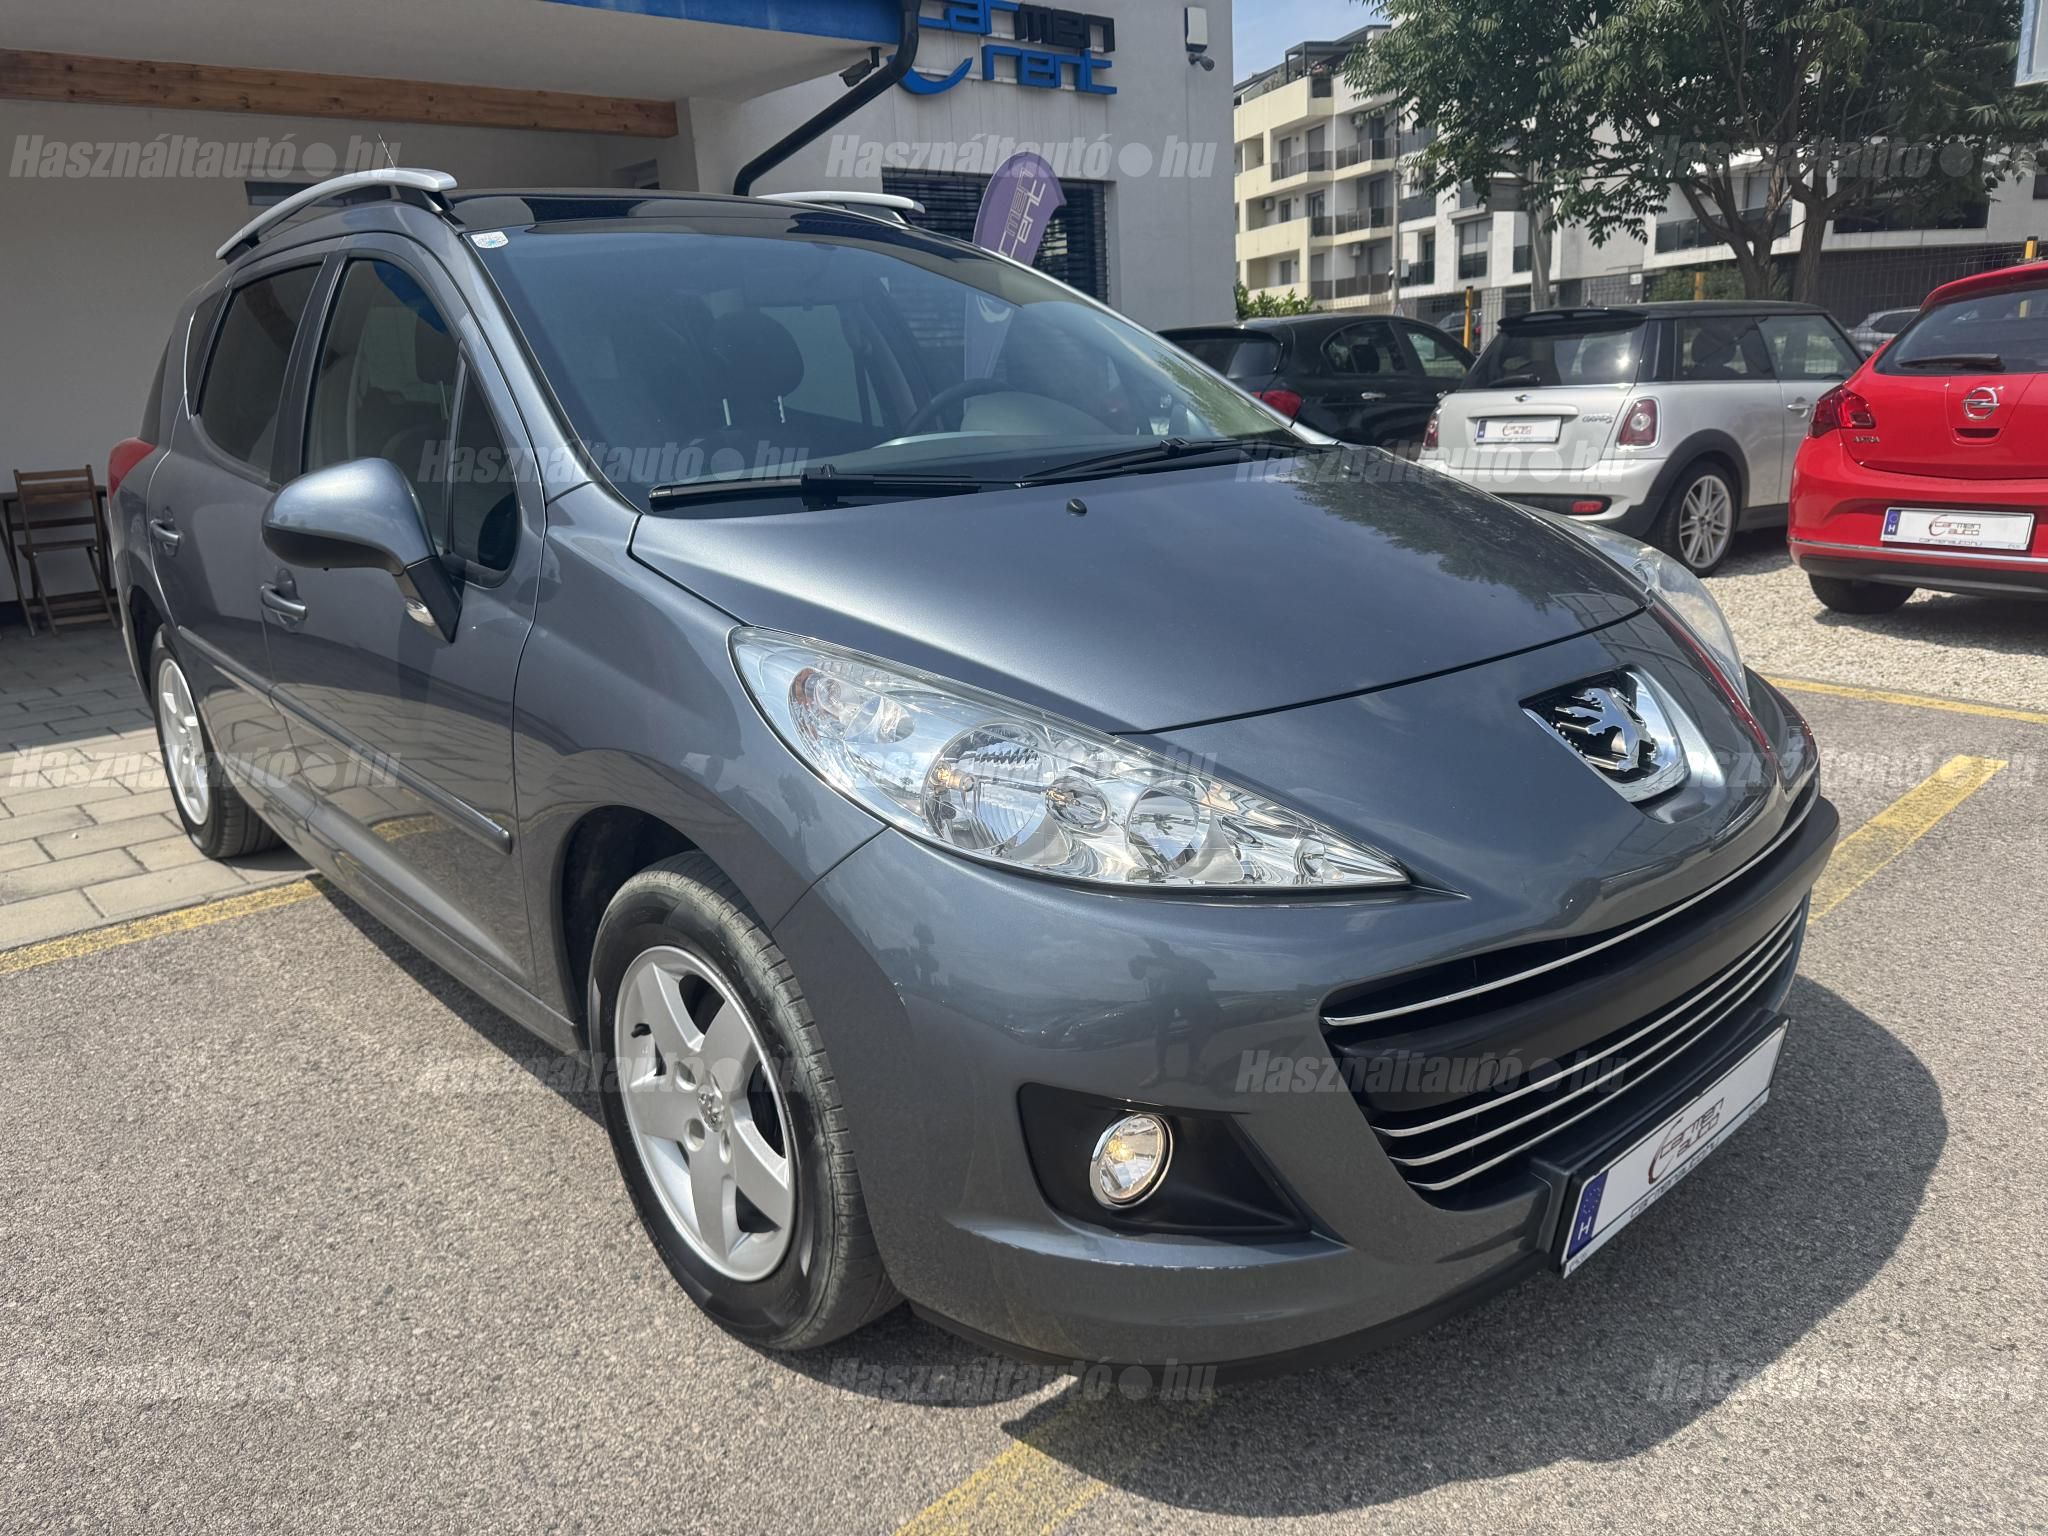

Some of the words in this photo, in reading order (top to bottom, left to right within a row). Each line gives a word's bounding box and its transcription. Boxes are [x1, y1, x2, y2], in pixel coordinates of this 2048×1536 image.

[919, 0, 1116, 53] armen
[981, 44, 1118, 95] rent
[1888, 524, 1895, 533] H
[1660, 1097, 1724, 1159] carmen
[1577, 1216, 1592, 1240] H
